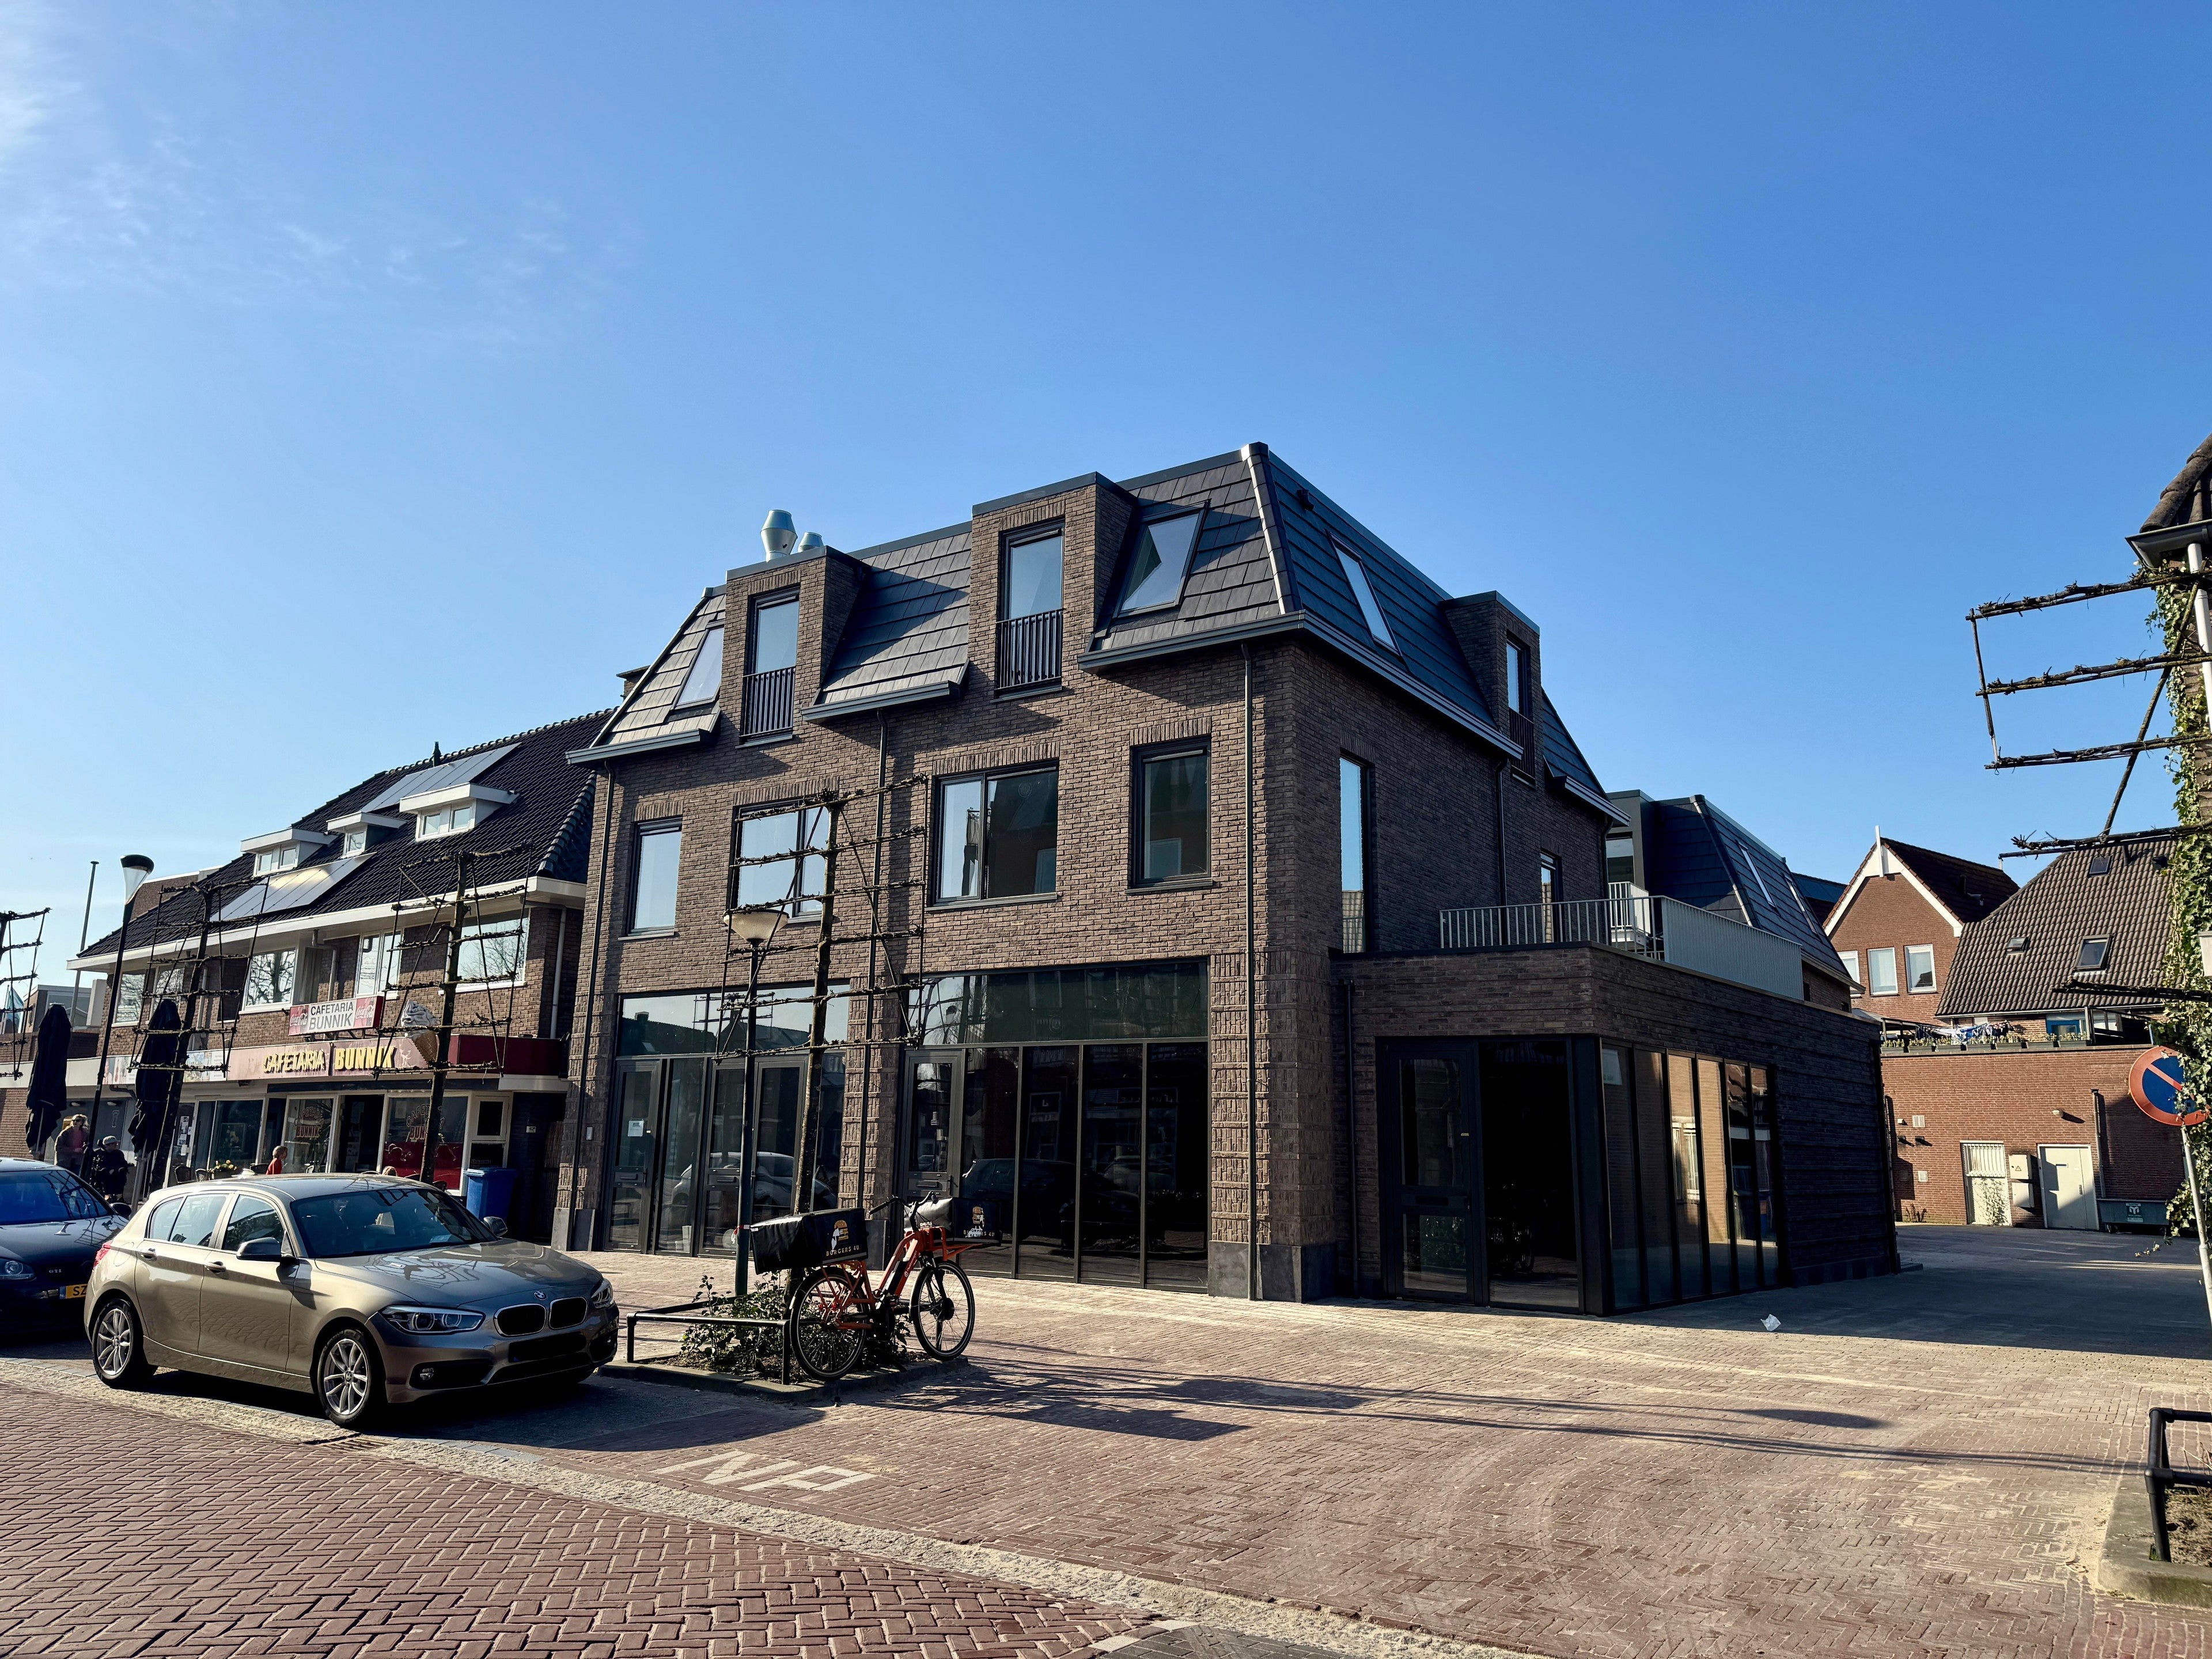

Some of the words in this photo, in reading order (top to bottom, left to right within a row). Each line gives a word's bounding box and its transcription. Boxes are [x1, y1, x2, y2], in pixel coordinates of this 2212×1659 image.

[310, 1001, 353, 1016] CAFETARIA
[309, 1013, 353, 1031] BUNNIK
[263, 1050, 326, 1073] CAFETARIA
[334, 1046, 395, 1071] BUNNIK
[826, 1246, 851, 1256] BURGERS
